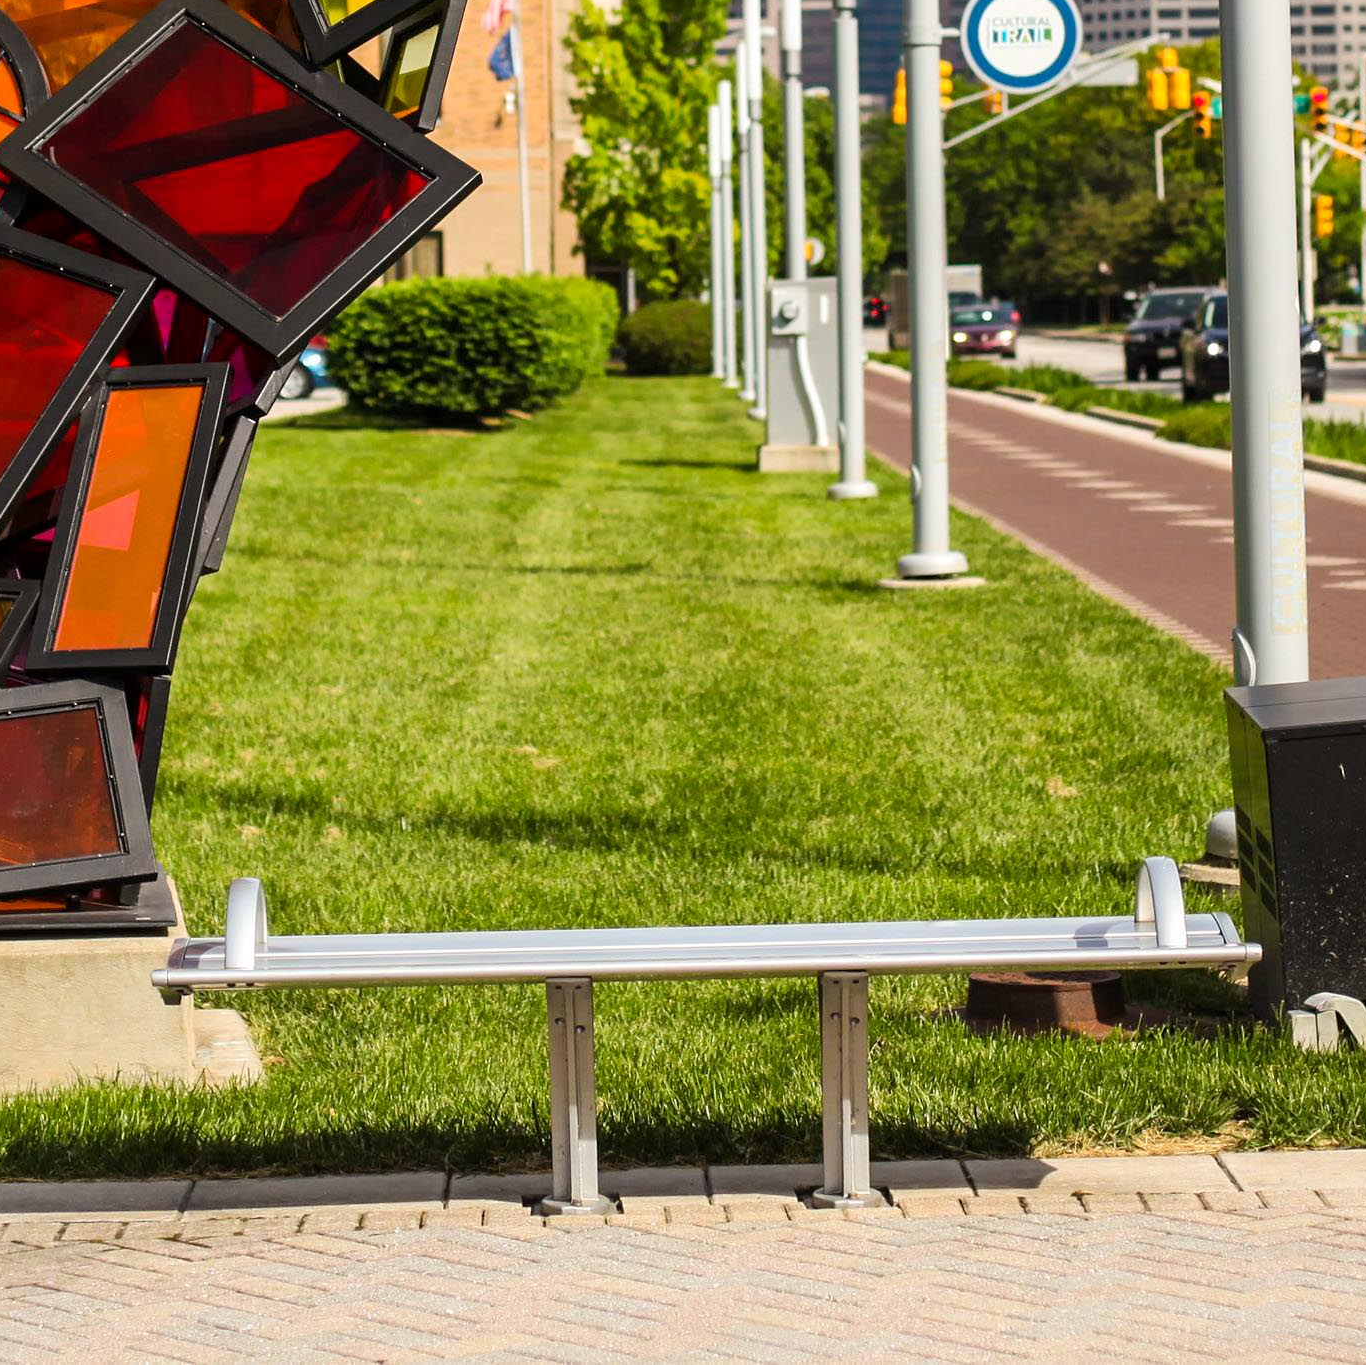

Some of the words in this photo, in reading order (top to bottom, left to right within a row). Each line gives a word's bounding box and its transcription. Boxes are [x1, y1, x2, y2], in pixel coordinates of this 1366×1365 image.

[991, 16, 1051, 27] CULTURAL
[992, 28, 1053, 44] TRAIL
[1270, 409, 1304, 628] CULTURAL
